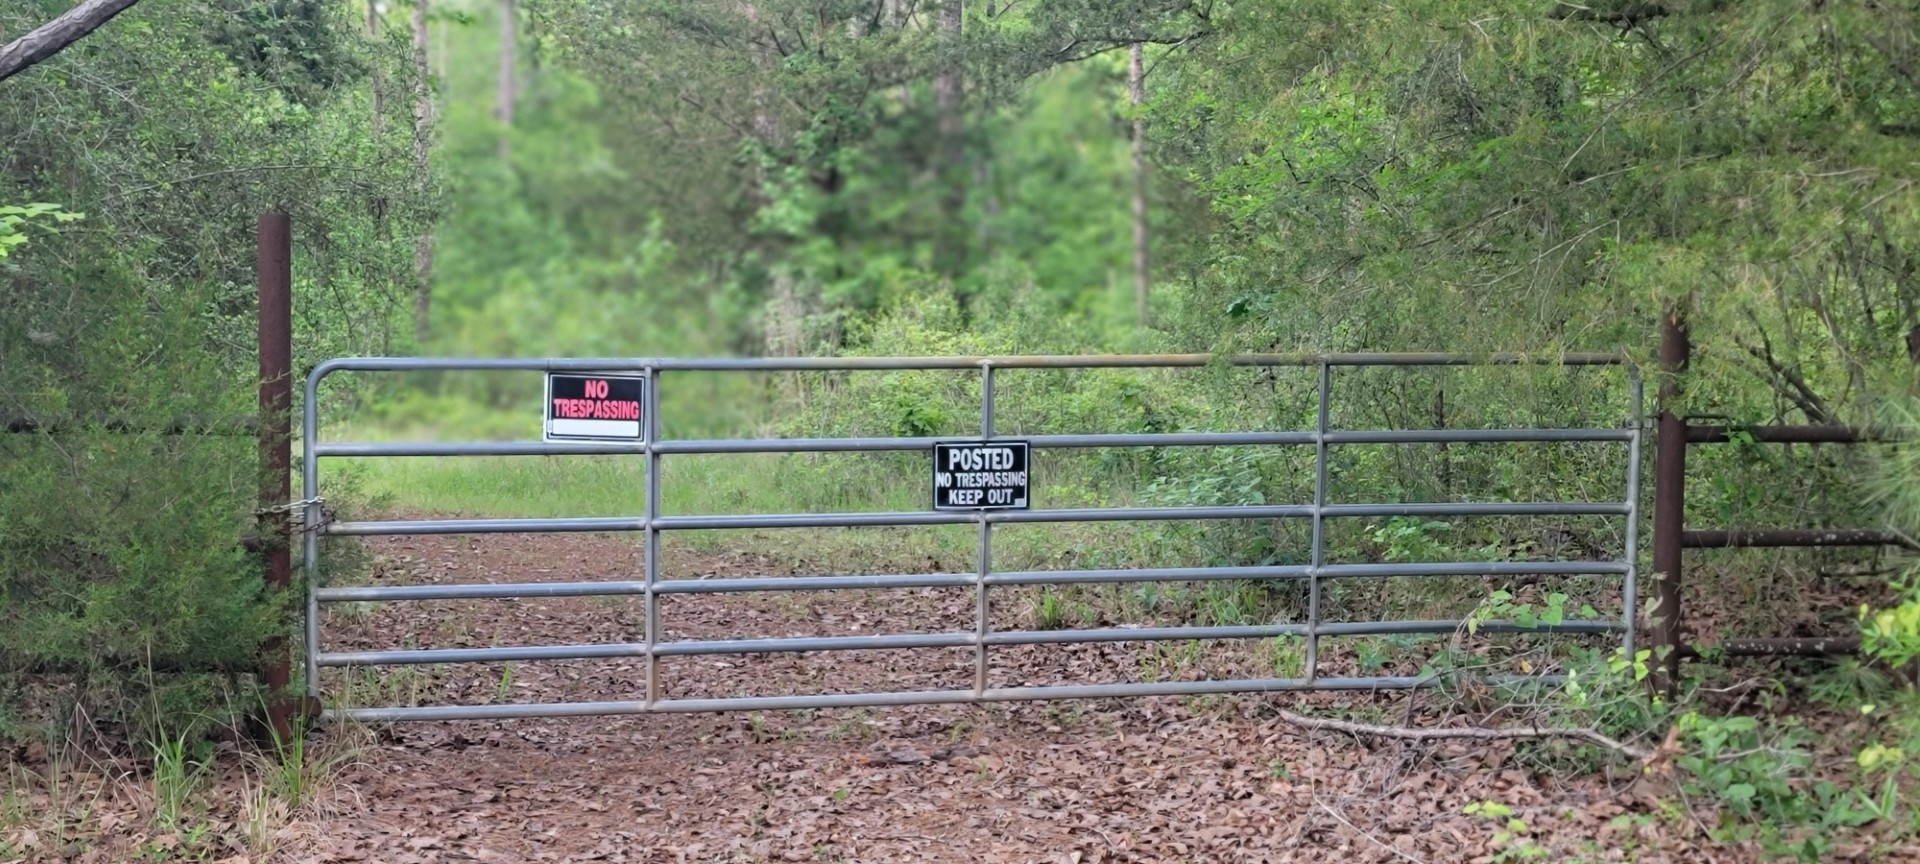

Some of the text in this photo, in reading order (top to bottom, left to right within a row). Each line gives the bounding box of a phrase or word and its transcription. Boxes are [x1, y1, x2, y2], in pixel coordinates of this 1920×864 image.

[585, 380, 609, 399] NO
[553, 399, 640, 419] TRESPASSING
[949, 448, 1014, 471] POSTED
[937, 471, 1026, 488] NO TRESPASSING
[949, 489, 984, 505] KEEP
[987, 488, 1013, 504] OUT
